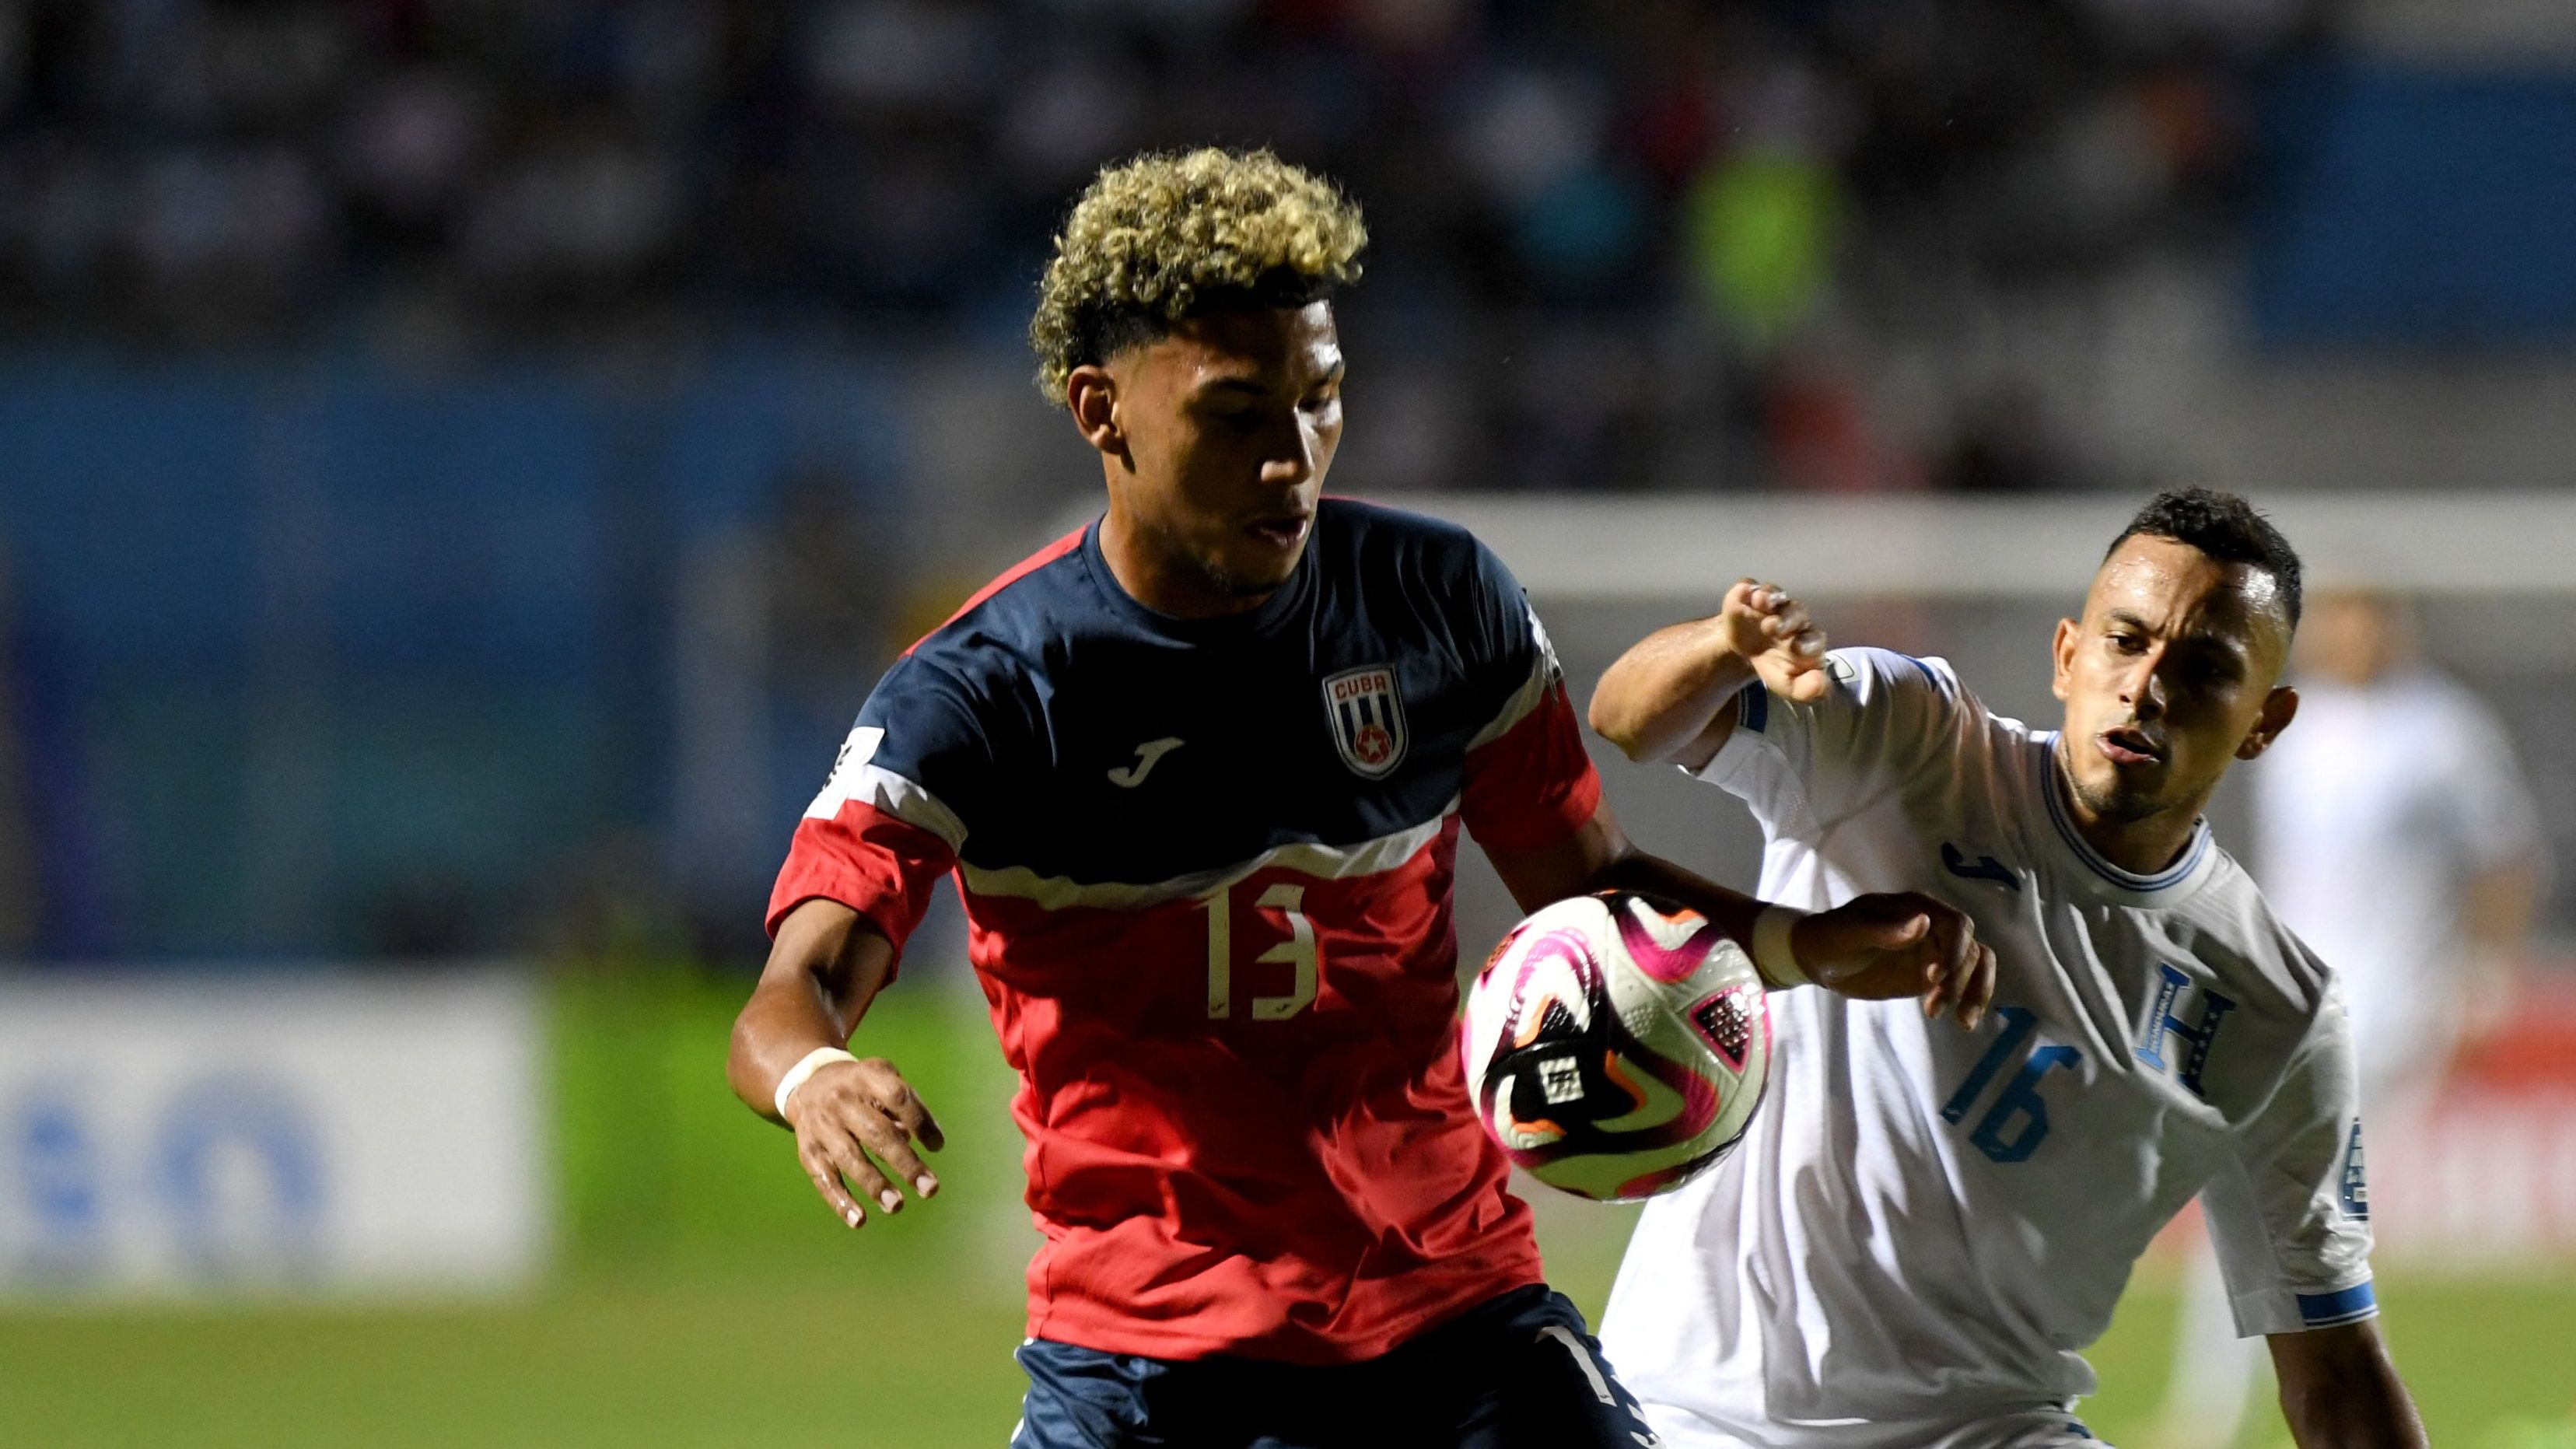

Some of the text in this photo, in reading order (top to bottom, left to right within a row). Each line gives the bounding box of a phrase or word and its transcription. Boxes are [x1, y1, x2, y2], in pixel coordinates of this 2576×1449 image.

[1335, 674, 1387, 701] CUBA
[1192, 882, 1318, 1020] 13
[1941, 1006, 2082, 1163] 16
